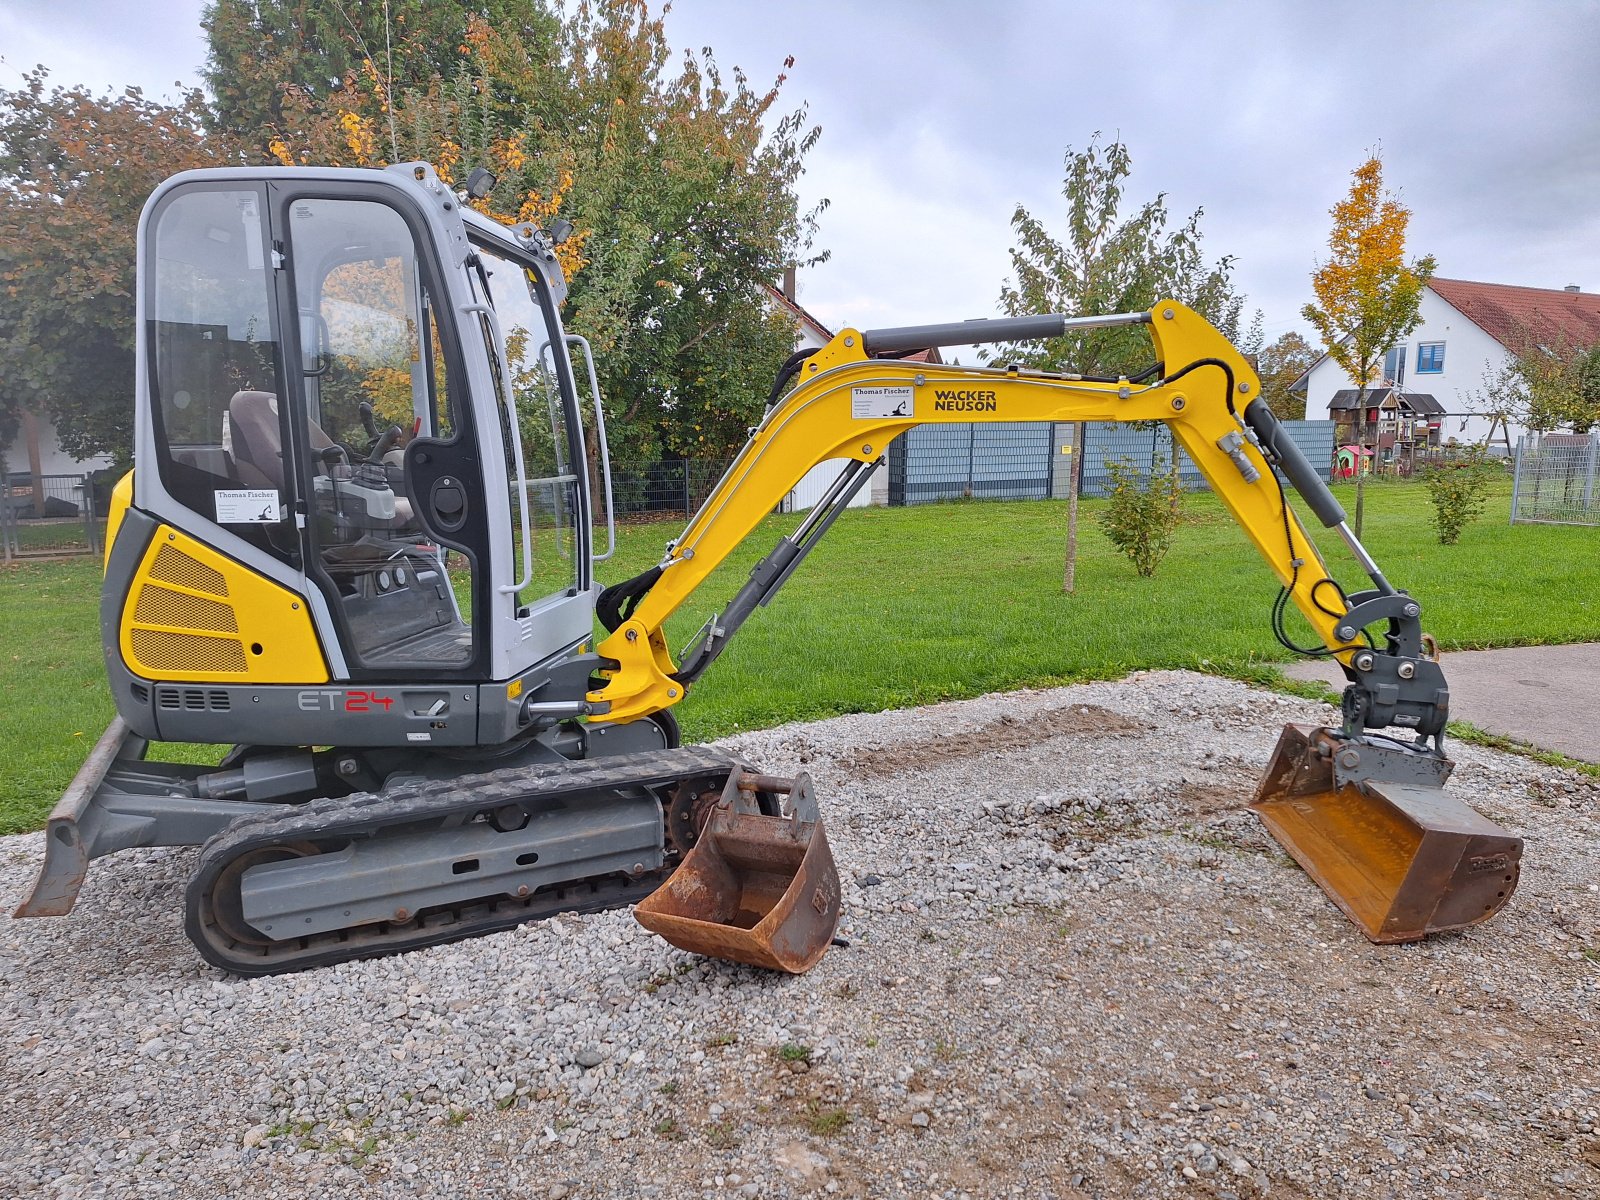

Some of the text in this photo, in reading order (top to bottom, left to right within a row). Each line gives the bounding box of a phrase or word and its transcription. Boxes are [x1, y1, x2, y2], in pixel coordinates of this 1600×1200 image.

[883, 387, 910, 395] Fischer
[934, 390, 996, 401] WACKER
[934, 400, 996, 412] NEUSON
